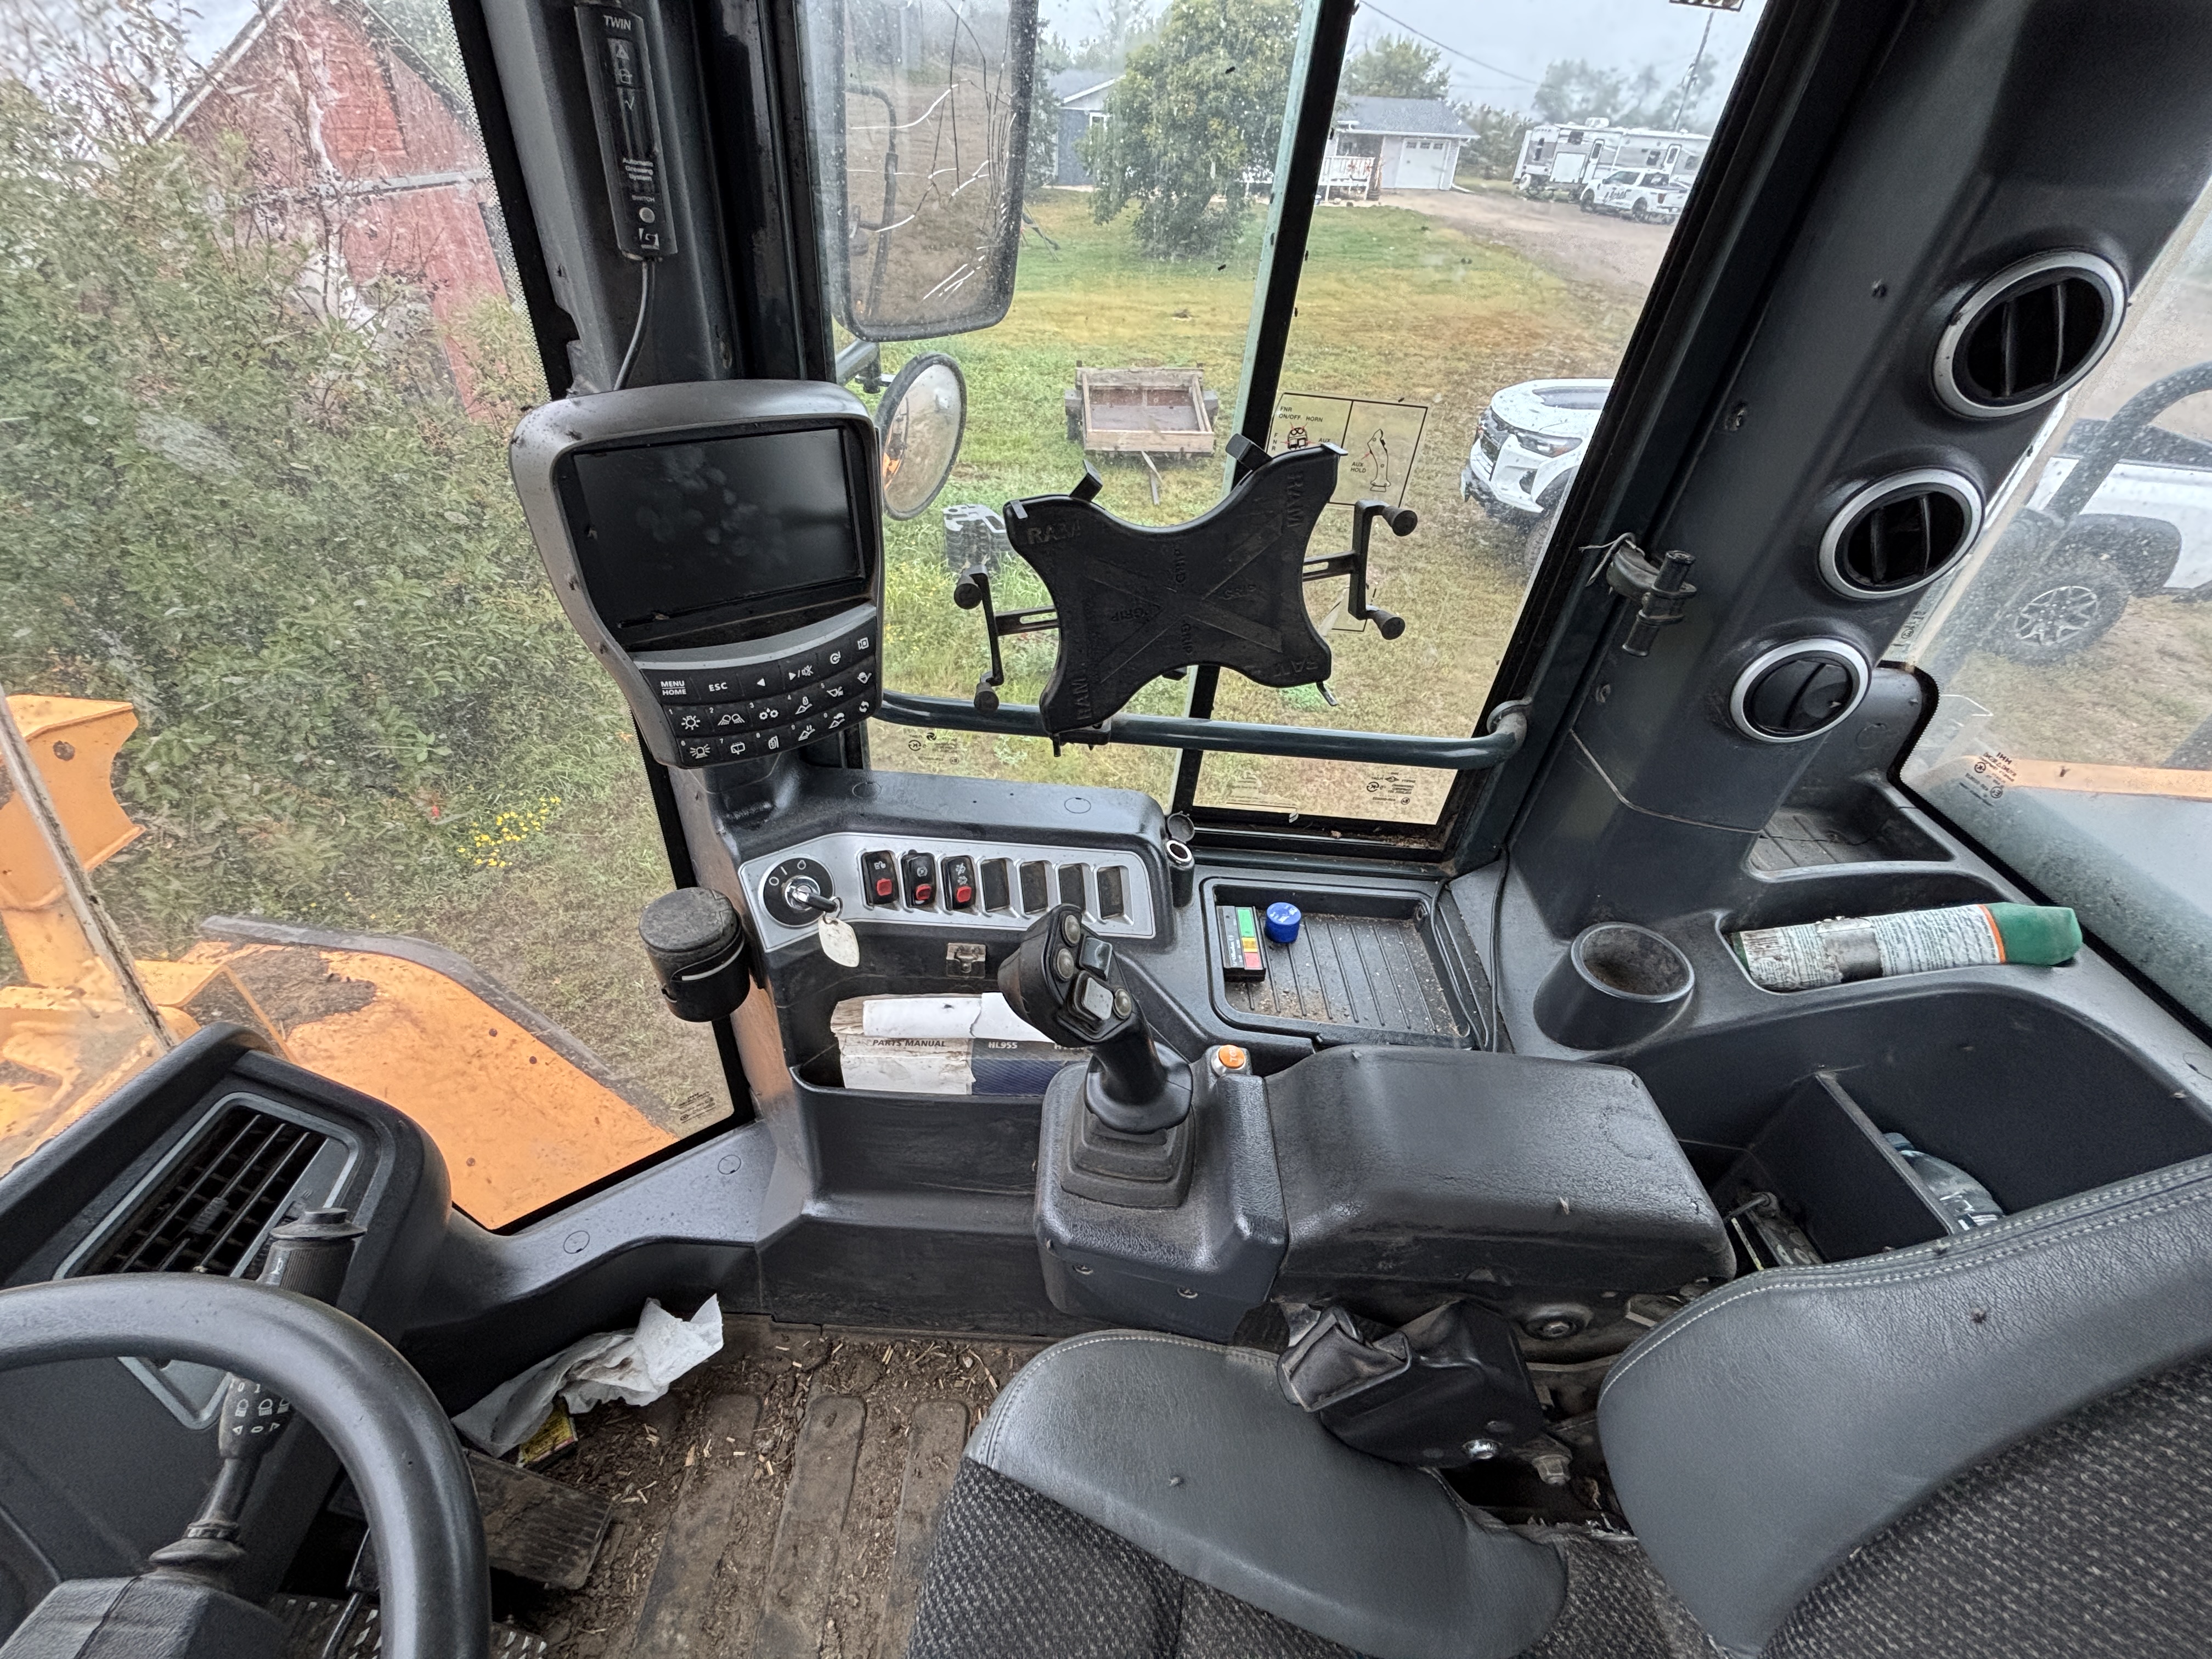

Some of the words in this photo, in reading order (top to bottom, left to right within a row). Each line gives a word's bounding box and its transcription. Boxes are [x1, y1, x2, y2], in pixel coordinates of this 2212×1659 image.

[603, 15, 631, 31] TWIN
[708, 682, 727, 691] ESC
[988, 1041, 1018, 1049] HL955
